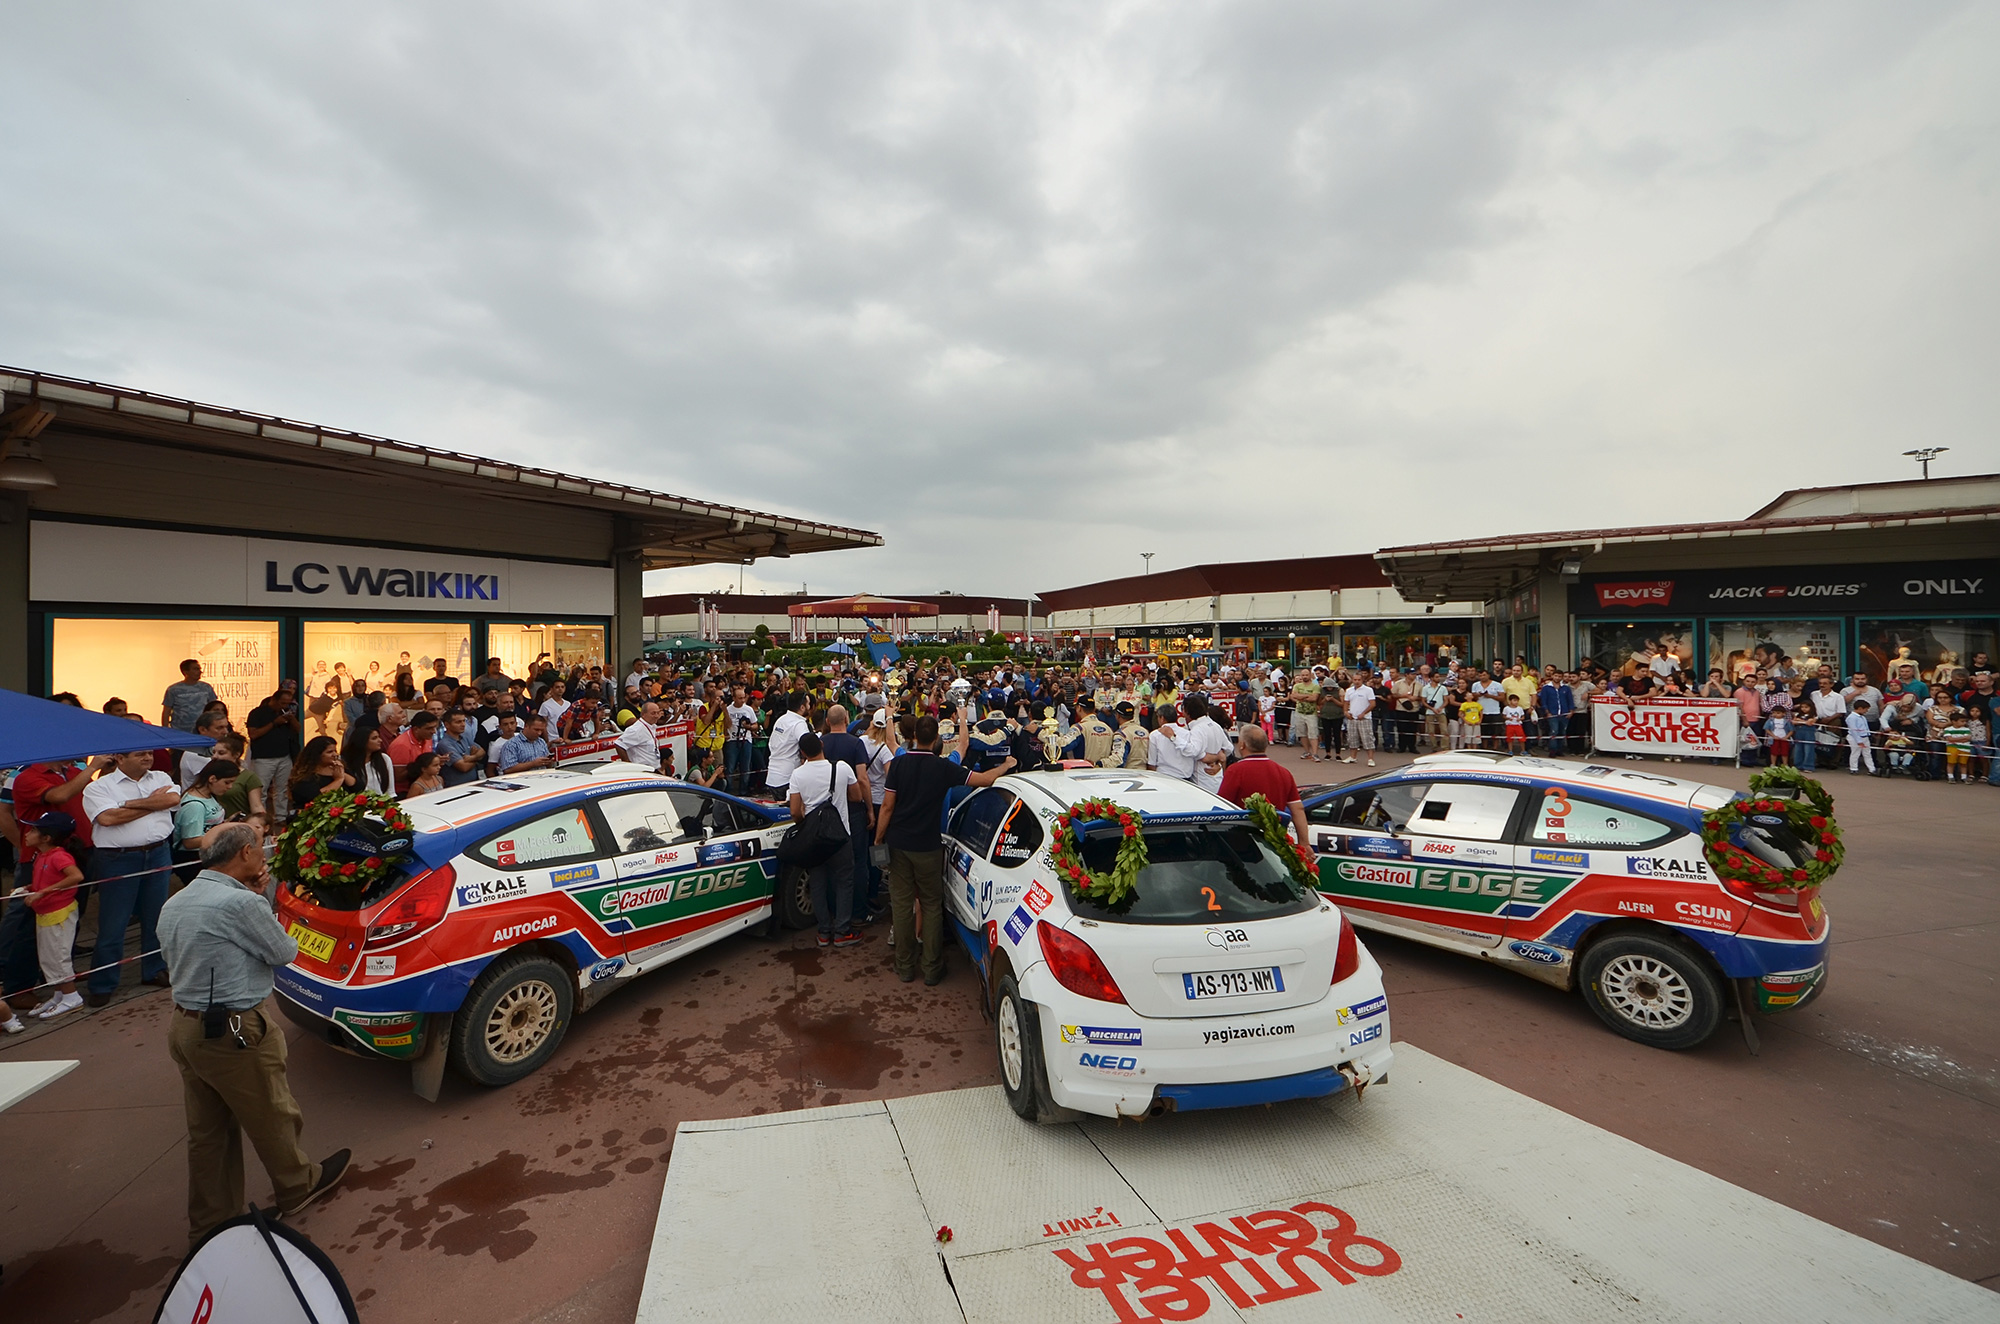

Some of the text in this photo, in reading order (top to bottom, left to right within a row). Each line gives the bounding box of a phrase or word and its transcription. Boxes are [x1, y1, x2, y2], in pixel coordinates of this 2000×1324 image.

[265, 560, 330, 595] LC
[1903, 578, 1983, 595] ONLY
[1709, 583, 1861, 599] JACK JONES
[235, 640, 258, 658] DERS
[1544, 786, 1572, 817] 3
[576, 808, 594, 840] 1
[1003, 799, 1023, 832] 2
[747, 840, 754, 856] 1
[1327, 836, 1338, 852] 3
[1652, 858, 1707, 874] KALE
[480, 875, 526, 895] KALE
[620, 866, 751, 910] Castrol EDGE
[1356, 865, 1547, 901] Castrol EDGE
[1201, 886, 1222, 911] 2
[1618, 901, 1655, 914] ALFEN
[1675, 901, 1732, 922] CSUN
[492, 915, 558, 944] AUTOCAR
[1679, 916, 1702, 924] energy
[1713, 921, 1733, 930] today
[1224, 928, 1249, 943] aa
[1519, 944, 1553, 963] Ford
[595, 961, 619, 980] Ford
[1187, 970, 1275, 997] F AS-913-NM
[1356, 1000, 1386, 1015] MICHELIN
[371, 1014, 414, 1026] EDGE
[1089, 1031, 1142, 1040] MICHELIN
[1203, 1023, 1295, 1045] yagizavci.com
[1350, 1022, 1382, 1046] NEO
[1079, 1052, 1138, 1070] NEO
